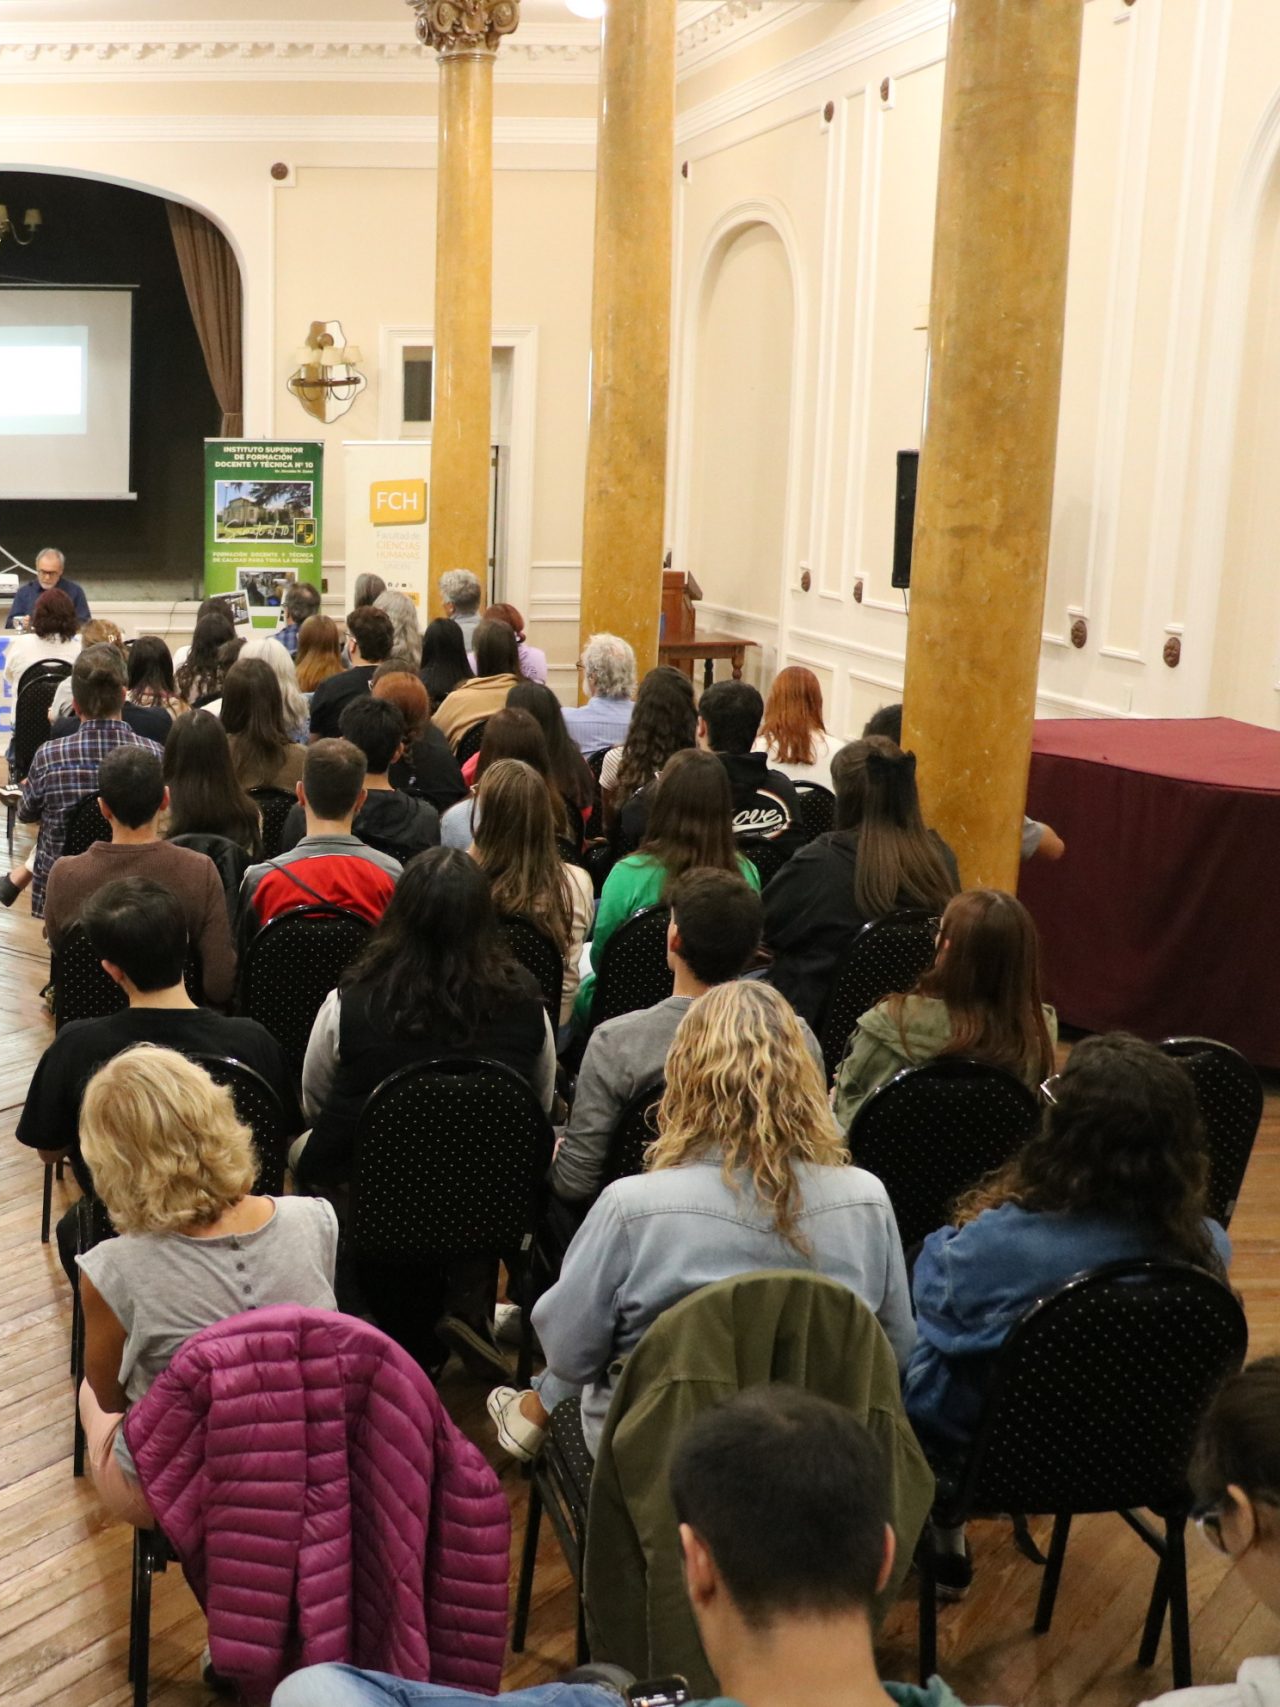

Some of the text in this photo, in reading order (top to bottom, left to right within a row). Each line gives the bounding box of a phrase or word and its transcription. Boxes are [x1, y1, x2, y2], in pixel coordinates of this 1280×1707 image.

[376, 491, 418, 511] FCH
[376, 541, 421, 551] CIENCIAS
[376, 551, 421, 560] HUMANAS
